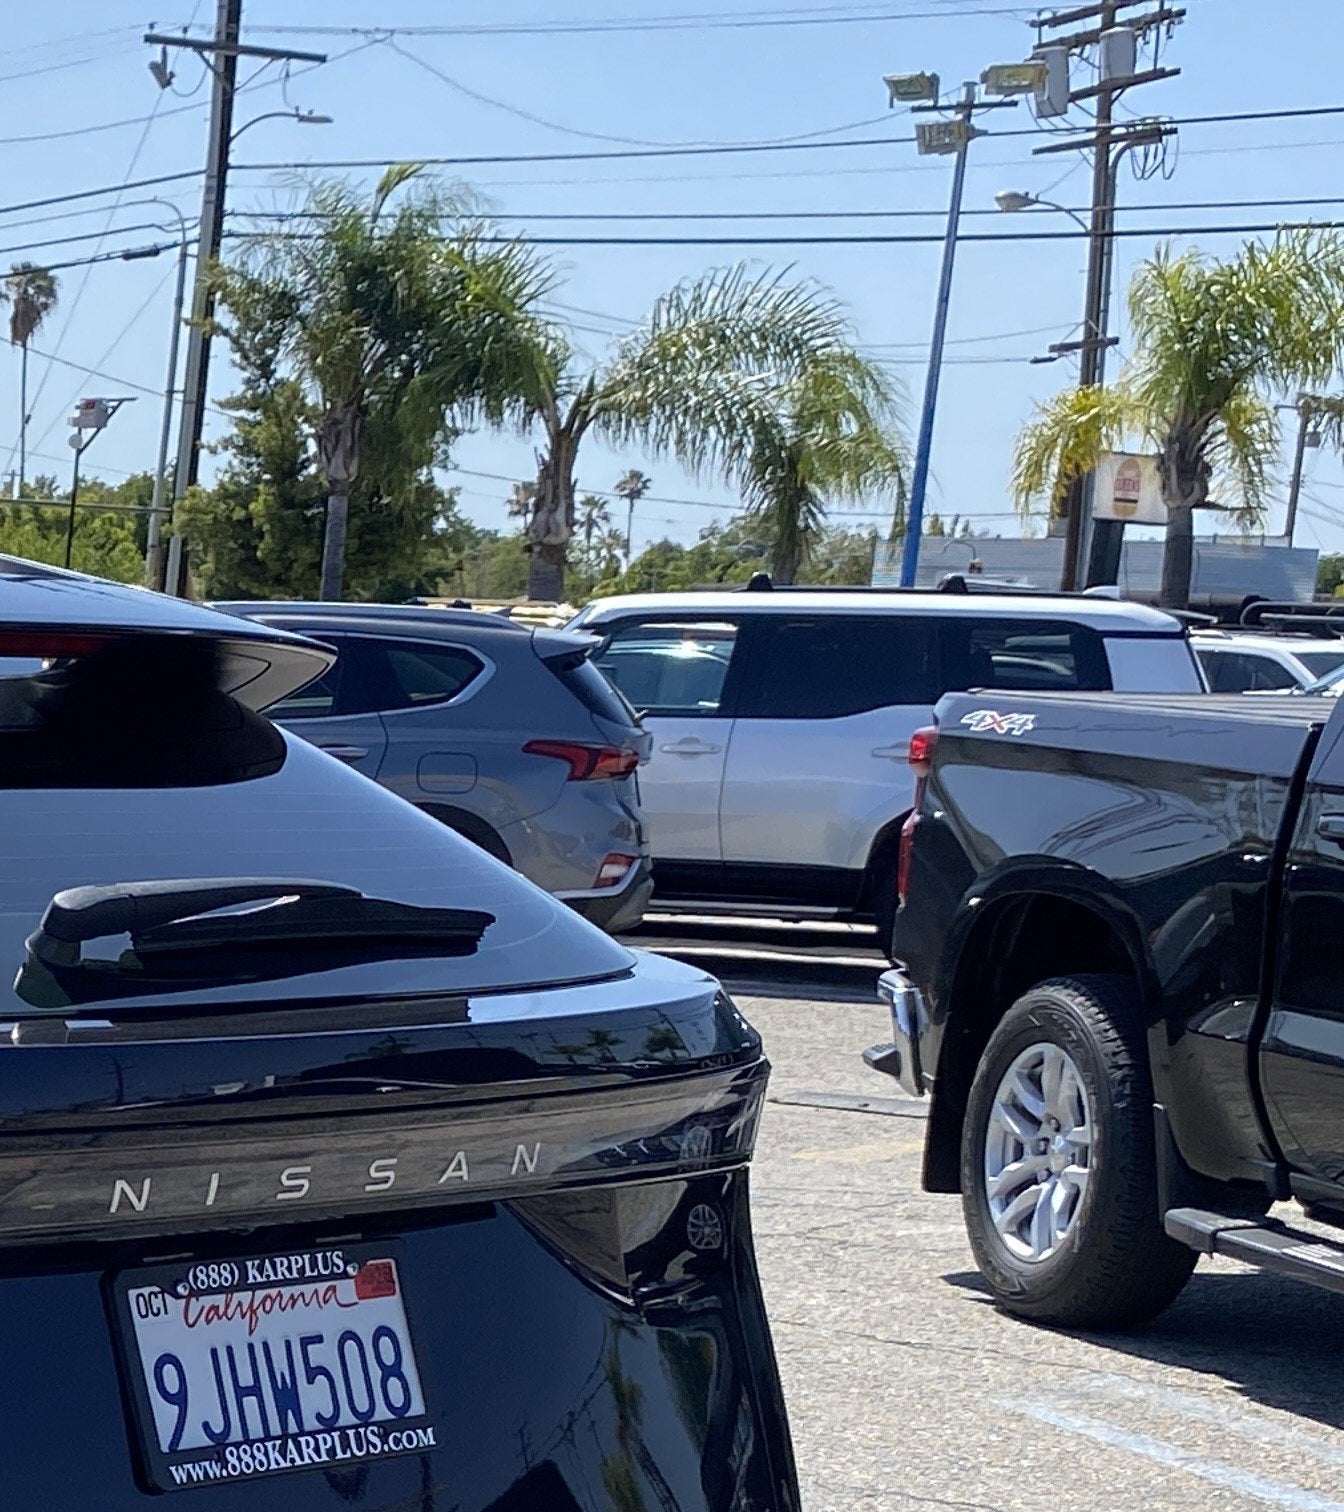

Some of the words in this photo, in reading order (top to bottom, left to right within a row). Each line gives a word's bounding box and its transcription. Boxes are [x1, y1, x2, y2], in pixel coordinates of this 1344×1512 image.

[110, 1142, 540, 1213] NISSAN
[187, 1265, 240, 1289] (888)
[247, 1251, 345, 1281] KARPLUS
[135, 1290, 170, 1319] OCT
[183, 1284, 358, 1335] California
[153, 1325, 413, 1450] 9JHW508
